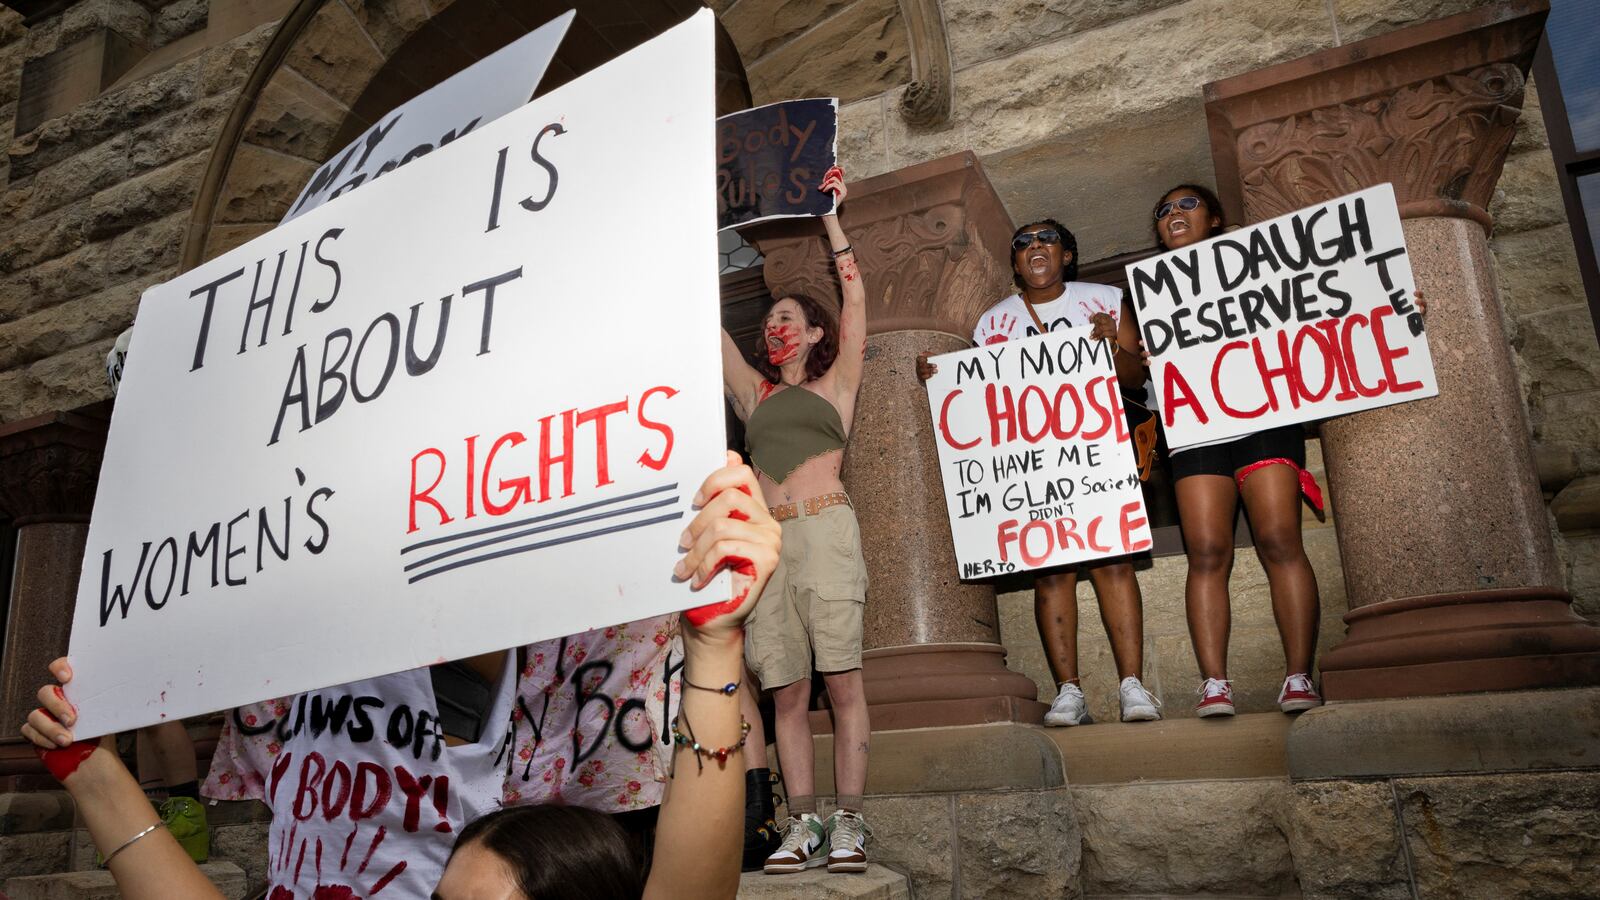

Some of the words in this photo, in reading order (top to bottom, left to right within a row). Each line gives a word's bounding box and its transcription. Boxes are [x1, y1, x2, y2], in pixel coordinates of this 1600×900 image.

[291, 113, 403, 216] MY
[717, 107, 817, 165] Body
[717, 167, 811, 214] Rules
[189, 228, 345, 373] THIS
[485, 123, 568, 233] IS
[1132, 249, 1202, 311] MY
[1142, 270, 1352, 357] DESERVES
[267, 265, 523, 447] ABOUT
[957, 347, 1005, 385] MY
[1020, 336, 1113, 379] MOM
[1163, 361, 1210, 428] A
[1210, 305, 1424, 420] CHOICE
[939, 375, 1130, 450] CHOOSE
[953, 458, 984, 487] TO
[992, 449, 1045, 483] HAVE
[1058, 444, 1101, 468] ME
[956, 486, 992, 519] I'M
[1002, 478, 1075, 512] GLAD
[100, 467, 336, 627] WOMEN'S
[406, 385, 681, 534] RIGHTS
[997, 501, 1153, 568] FORCE
[1029, 502, 1075, 521] DIDN'T
[963, 559, 996, 579] HER
[292, 750, 453, 833] BODY!
